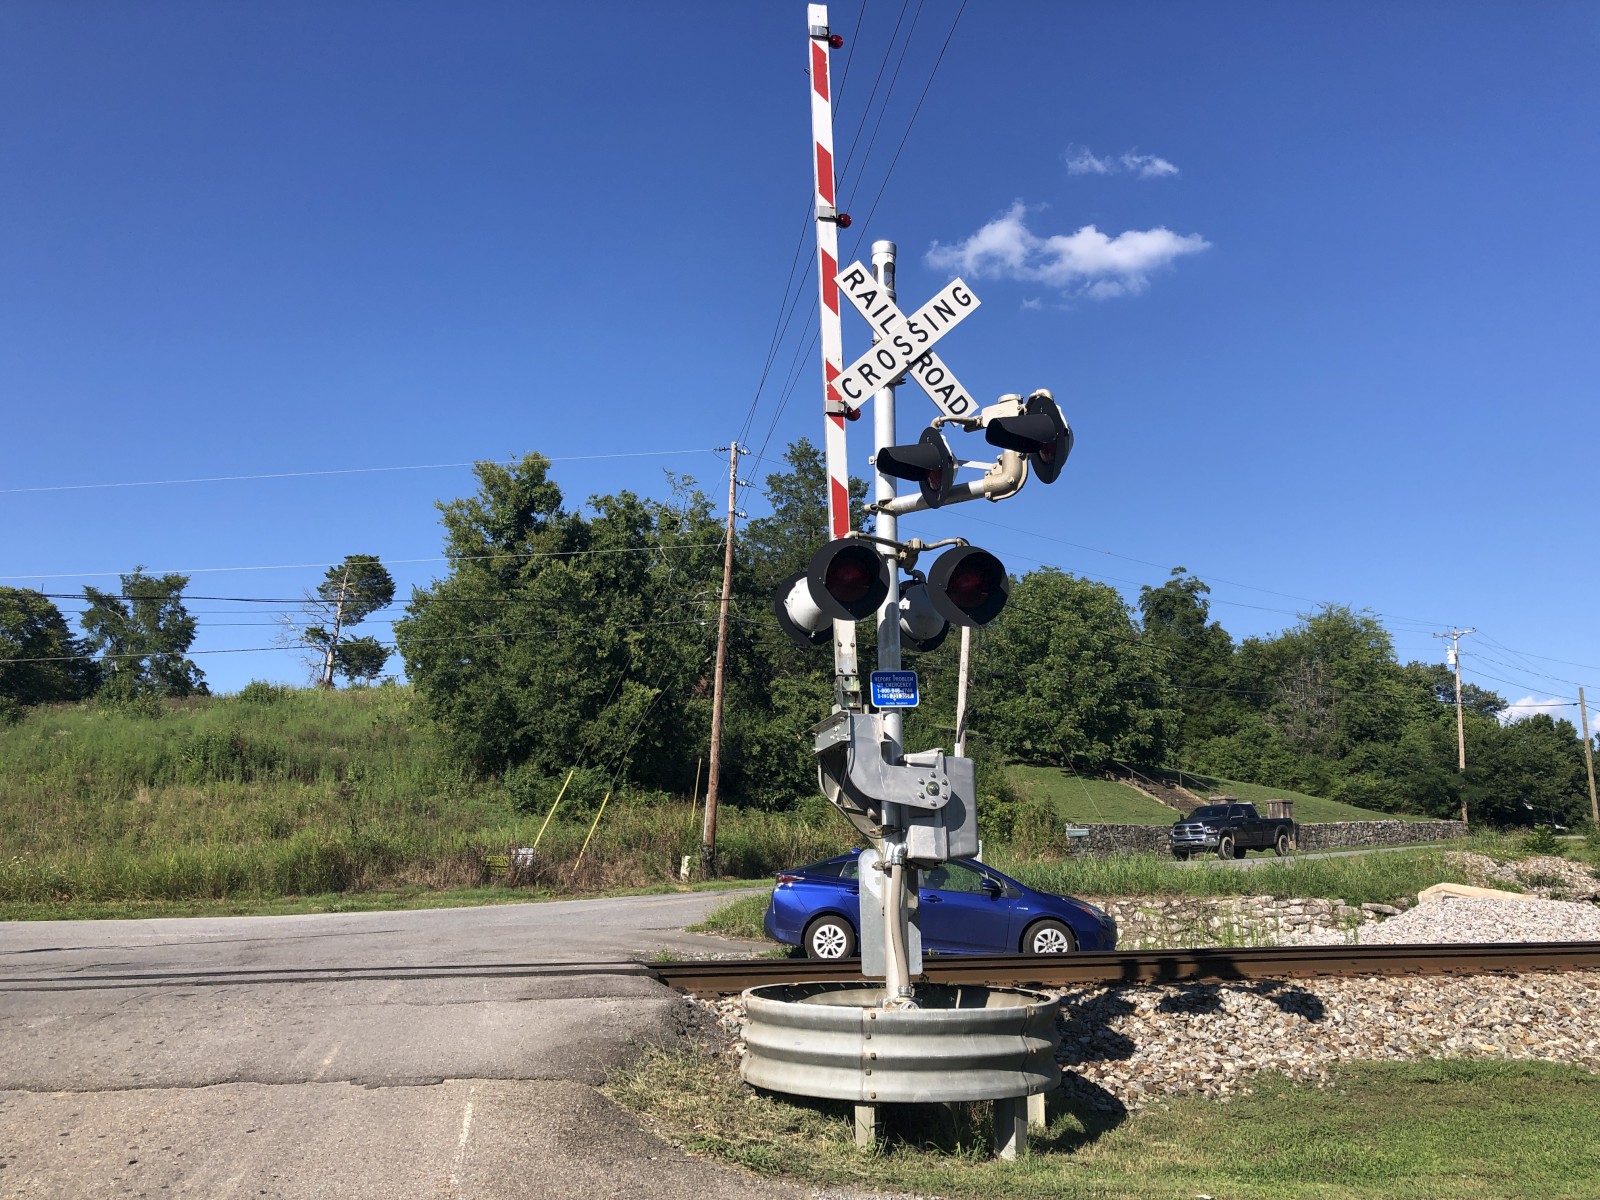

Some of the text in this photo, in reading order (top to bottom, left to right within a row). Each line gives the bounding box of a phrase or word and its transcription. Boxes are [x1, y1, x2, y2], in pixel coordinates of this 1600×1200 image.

[842, 286, 972, 399] CROSSING
[843, 268, 969, 415] RAIL ROAD
